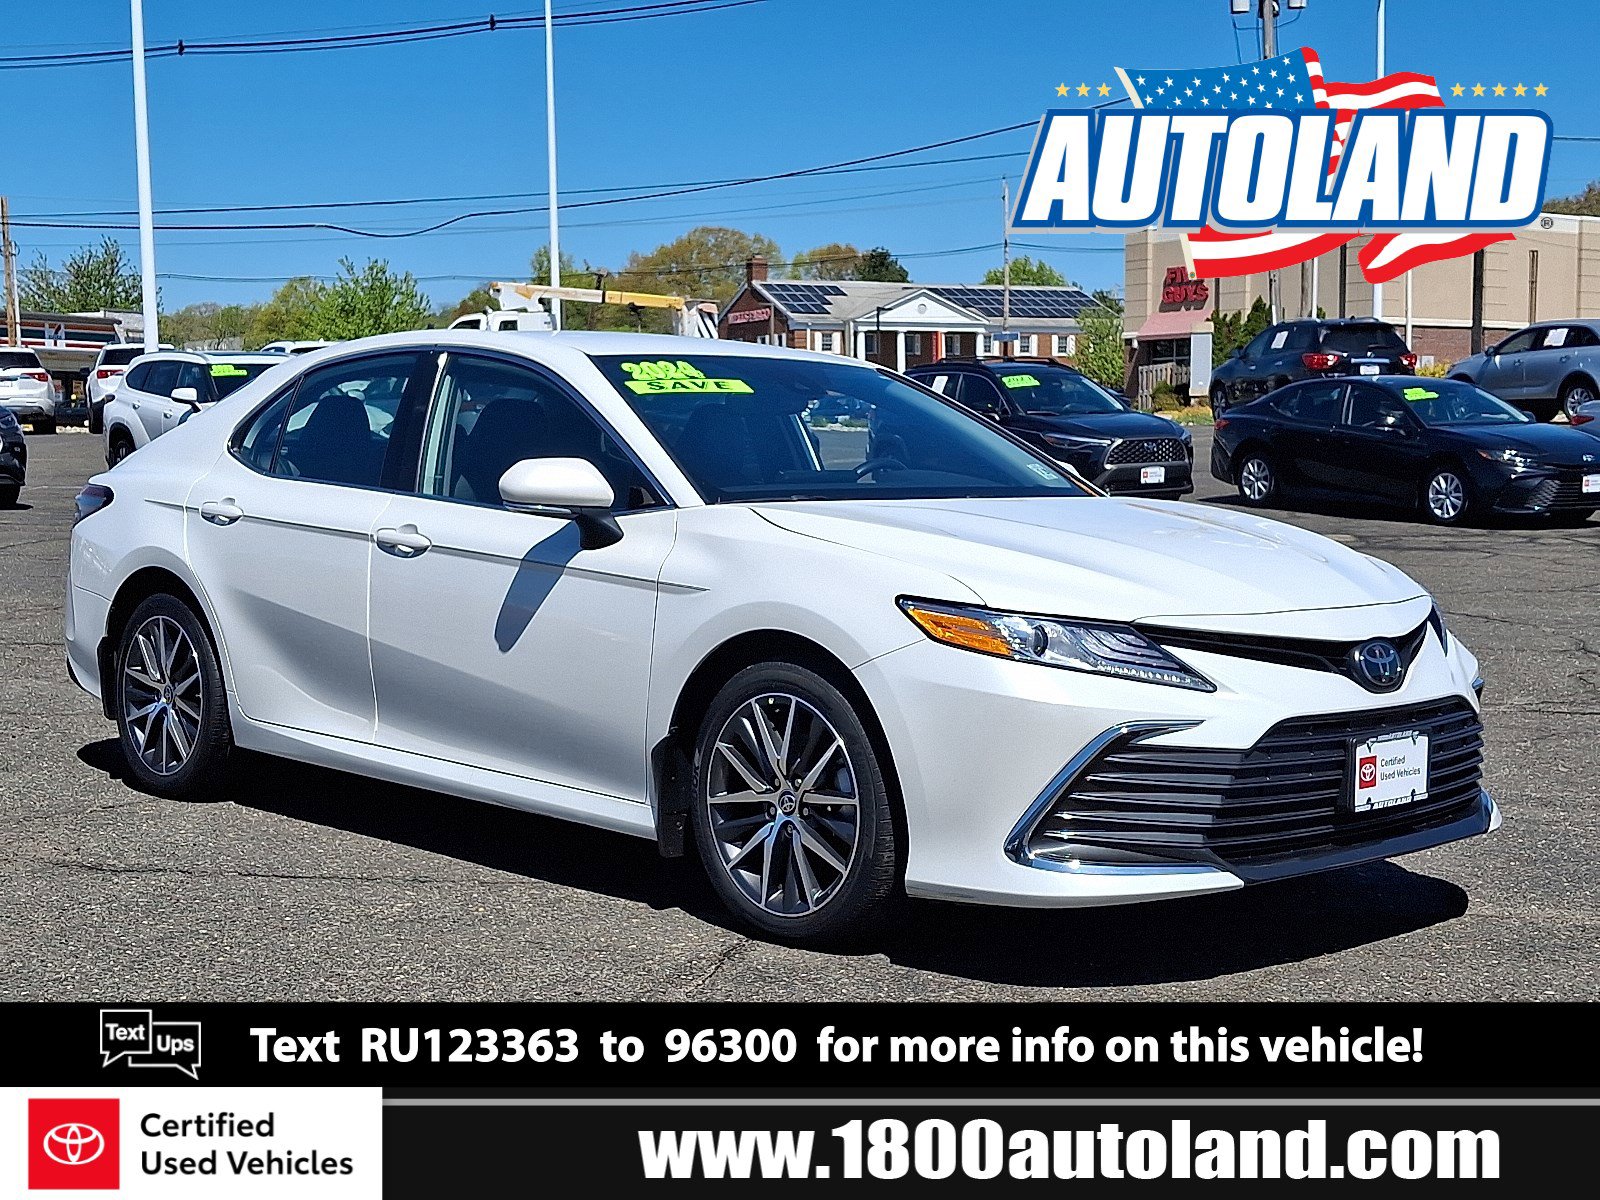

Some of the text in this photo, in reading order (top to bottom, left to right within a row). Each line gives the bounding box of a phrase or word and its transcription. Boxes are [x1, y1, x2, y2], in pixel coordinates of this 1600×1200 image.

[1162, 284, 1209, 304] GUYS
[621, 360, 706, 380] 2024
[646, 380, 731, 391] SAVE
[1380, 755, 1406, 768] Certified
[1380, 767, 1421, 782] Used Vehicles
[1372, 794, 1412, 810] AUTOLAND
